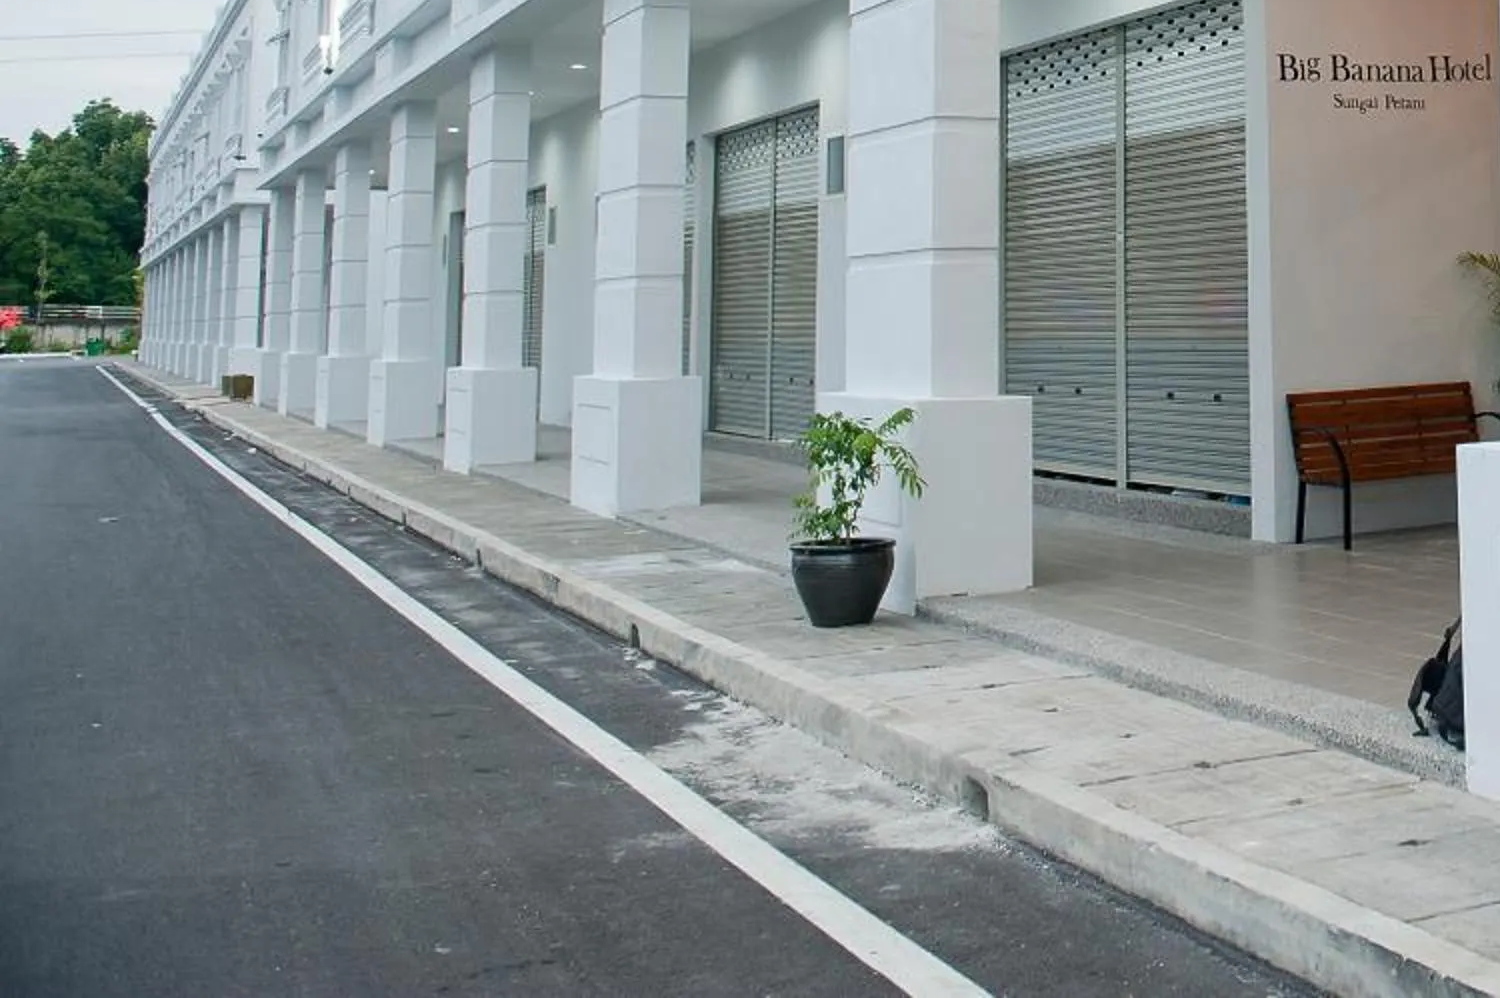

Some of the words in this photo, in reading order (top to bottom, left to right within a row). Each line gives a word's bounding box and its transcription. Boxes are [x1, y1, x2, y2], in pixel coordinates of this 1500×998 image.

[1277, 53, 1321, 83] Big
[1330, 53, 1424, 83] Banana
[1428, 53, 1492, 83] Hotel
[1332, 93, 1379, 114] Sungai
[1384, 93, 1426, 111] Petani
